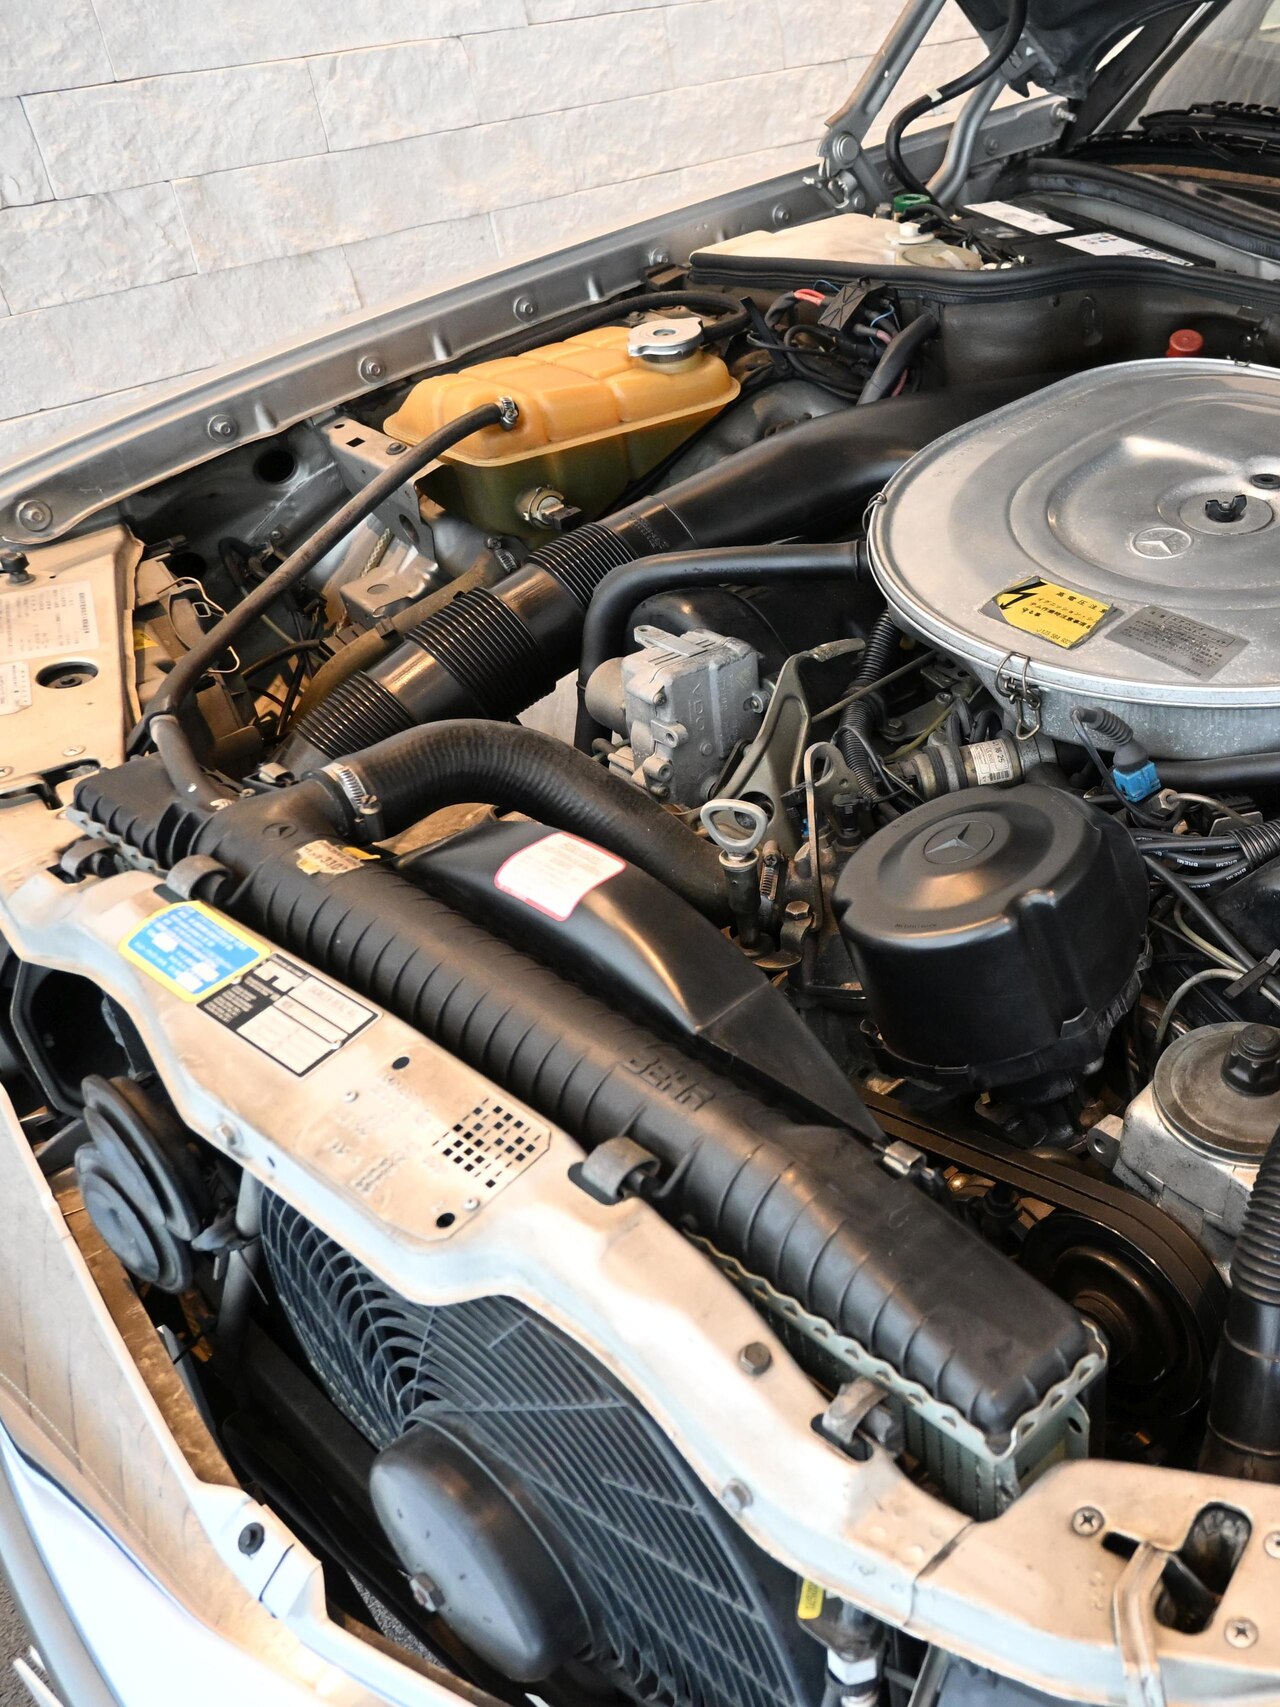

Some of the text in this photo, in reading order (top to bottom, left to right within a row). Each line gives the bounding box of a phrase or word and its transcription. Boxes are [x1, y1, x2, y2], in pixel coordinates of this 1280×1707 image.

[1176, 858, 1199, 868] BREMI
[1225, 867, 1247, 881] BREMI
[621, 1056, 717, 1112] BEHR
